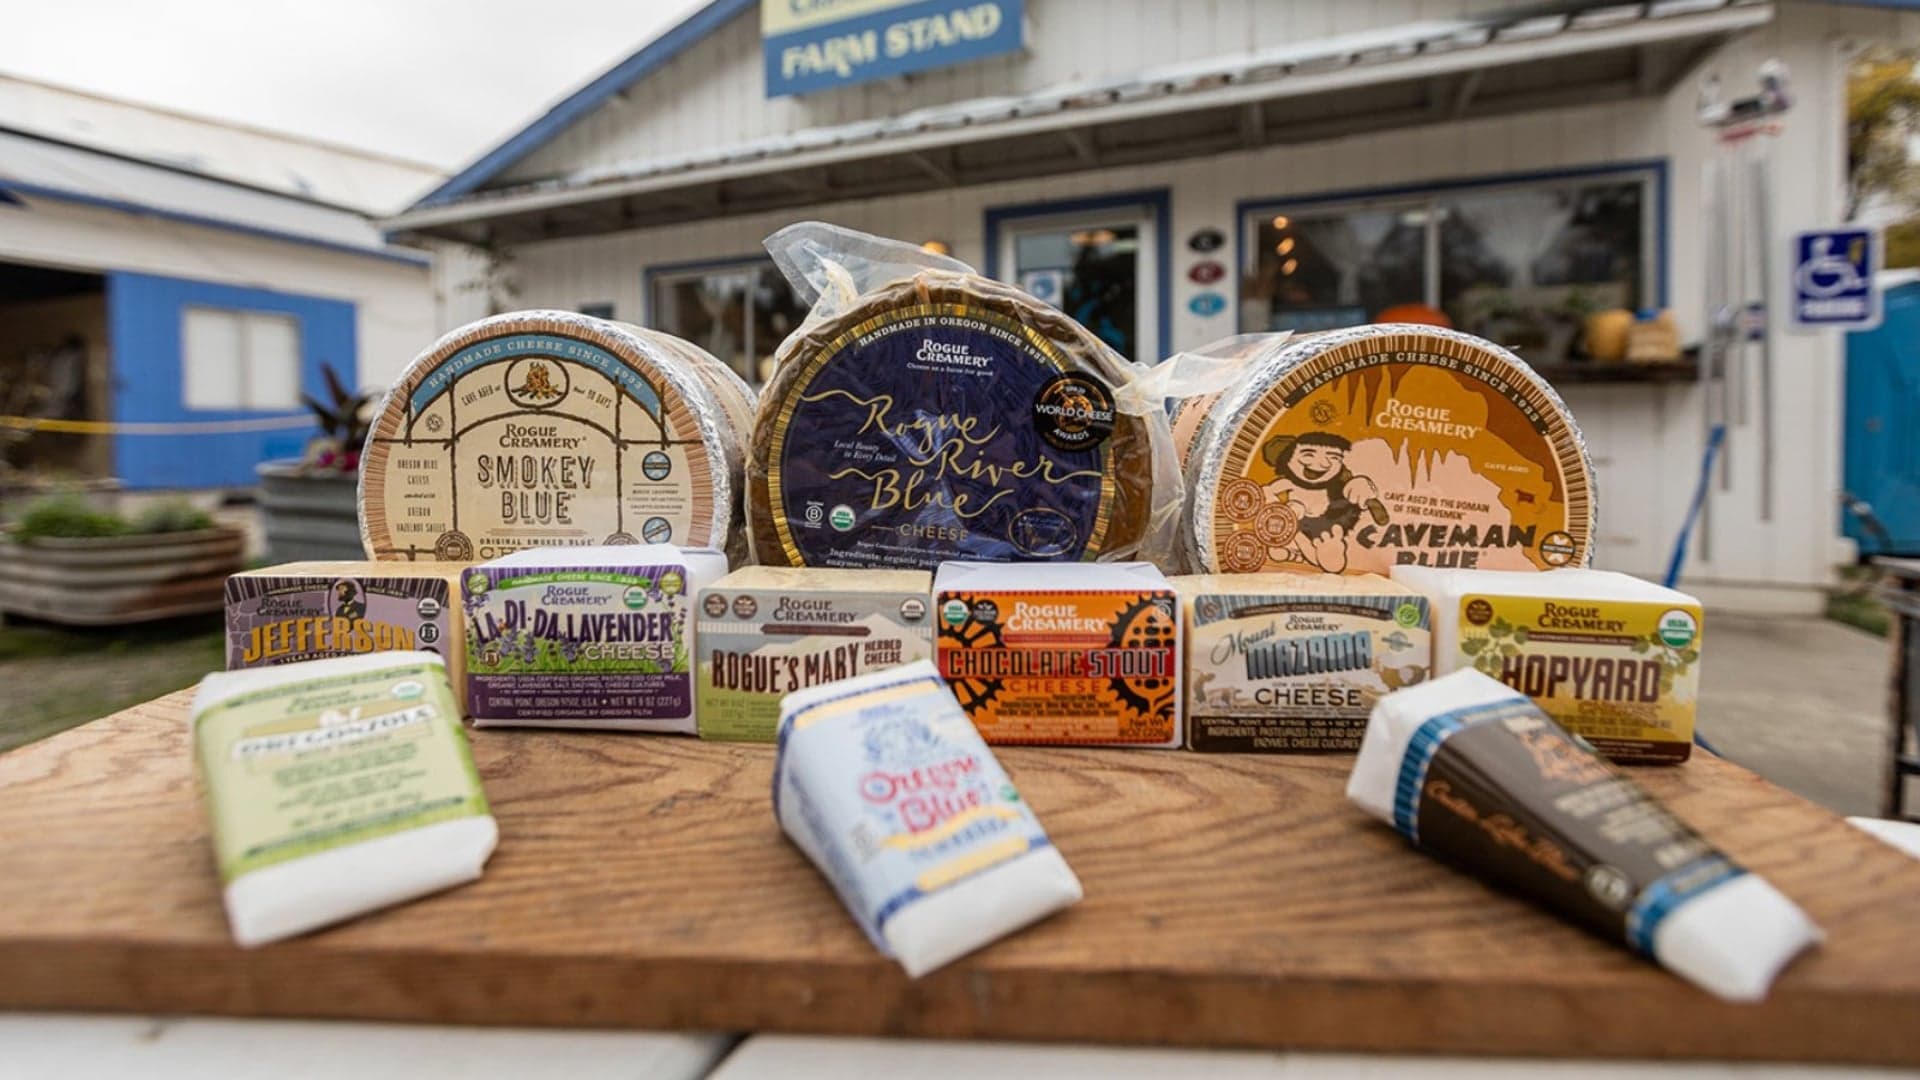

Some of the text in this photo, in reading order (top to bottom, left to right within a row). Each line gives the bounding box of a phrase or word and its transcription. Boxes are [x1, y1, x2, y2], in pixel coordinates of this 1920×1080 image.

[781, 3, 1001, 80] FARM STAND
[858, 317, 921, 347] HANDMADE
[924, 317, 937, 325] IN
[940, 317, 987, 331] OREGON
[989, 327, 1021, 347] SINCE
[923, 338, 969, 355] ROGUE
[429, 344, 501, 388] HANDMADE
[507, 340, 563, 352] CHEESE
[567, 346, 609, 368] SINCE
[916, 350, 989, 368] CREAMERY
[1301, 354, 1389, 393] HANDMADE
[1396, 351, 1458, 368] CHEESE
[1464, 364, 1509, 393] SINCE
[1035, 403, 1113, 422] WORLD CHEESE
[1386, 399, 1451, 421] ROGUE
[505, 423, 557, 438] ROGUE
[815, 390, 1000, 455] Rogue
[1376, 412, 1478, 440] CREAMERY
[499, 435, 581, 449] CREAMERY
[1053, 428, 1090, 441] AWARDS
[910, 438, 1101, 486] River
[477, 454, 595, 489] SMOKEY
[835, 468, 1013, 518] Blue
[1384, 492, 1490, 512] CAVE AGED IN THE DOMAIN
[501, 490, 573, 524] BLUE
[1393, 503, 1463, 520] OF THE CAVEMEN
[900, 523, 968, 542] CHEESE
[1356, 523, 1536, 549] CAVEMAN
[546, 585, 588, 597] ROGUE
[261, 597, 302, 609] ROGUE
[540, 595, 606, 607] CREAMERY
[780, 597, 832, 612] ROGUE
[1014, 602, 1078, 618] ROGUE
[256, 606, 320, 617] CREAMERY
[773, 610, 858, 623] CREAMERY
[1289, 614, 1324, 625] ROGUE
[1545, 603, 1600, 618] ROGUE
[566, 612, 673, 642] LAVENDER
[1007, 615, 1108, 632] CREAMERY
[1284, 622, 1341, 632] CREAMERY
[1538, 614, 1623, 632] CREAMERY
[1667, 619, 1689, 628] USDA
[242, 616, 416, 663] JEFFERSON
[864, 639, 902, 652] HERBED
[1210, 622, 1276, 666] Mount
[584, 645, 674, 661] CHEESE
[864, 651, 902, 665] CHEESE
[1247, 630, 1371, 680] MAZAMA
[713, 643, 860, 693] ROGUE'S MARY
[949, 649, 1170, 678] CHOCOLATE STOUT
[1009, 680, 1102, 693] CHEESE
[1503, 654, 1661, 702] HOPYARD
[1255, 687, 1362, 706] CHEESE
